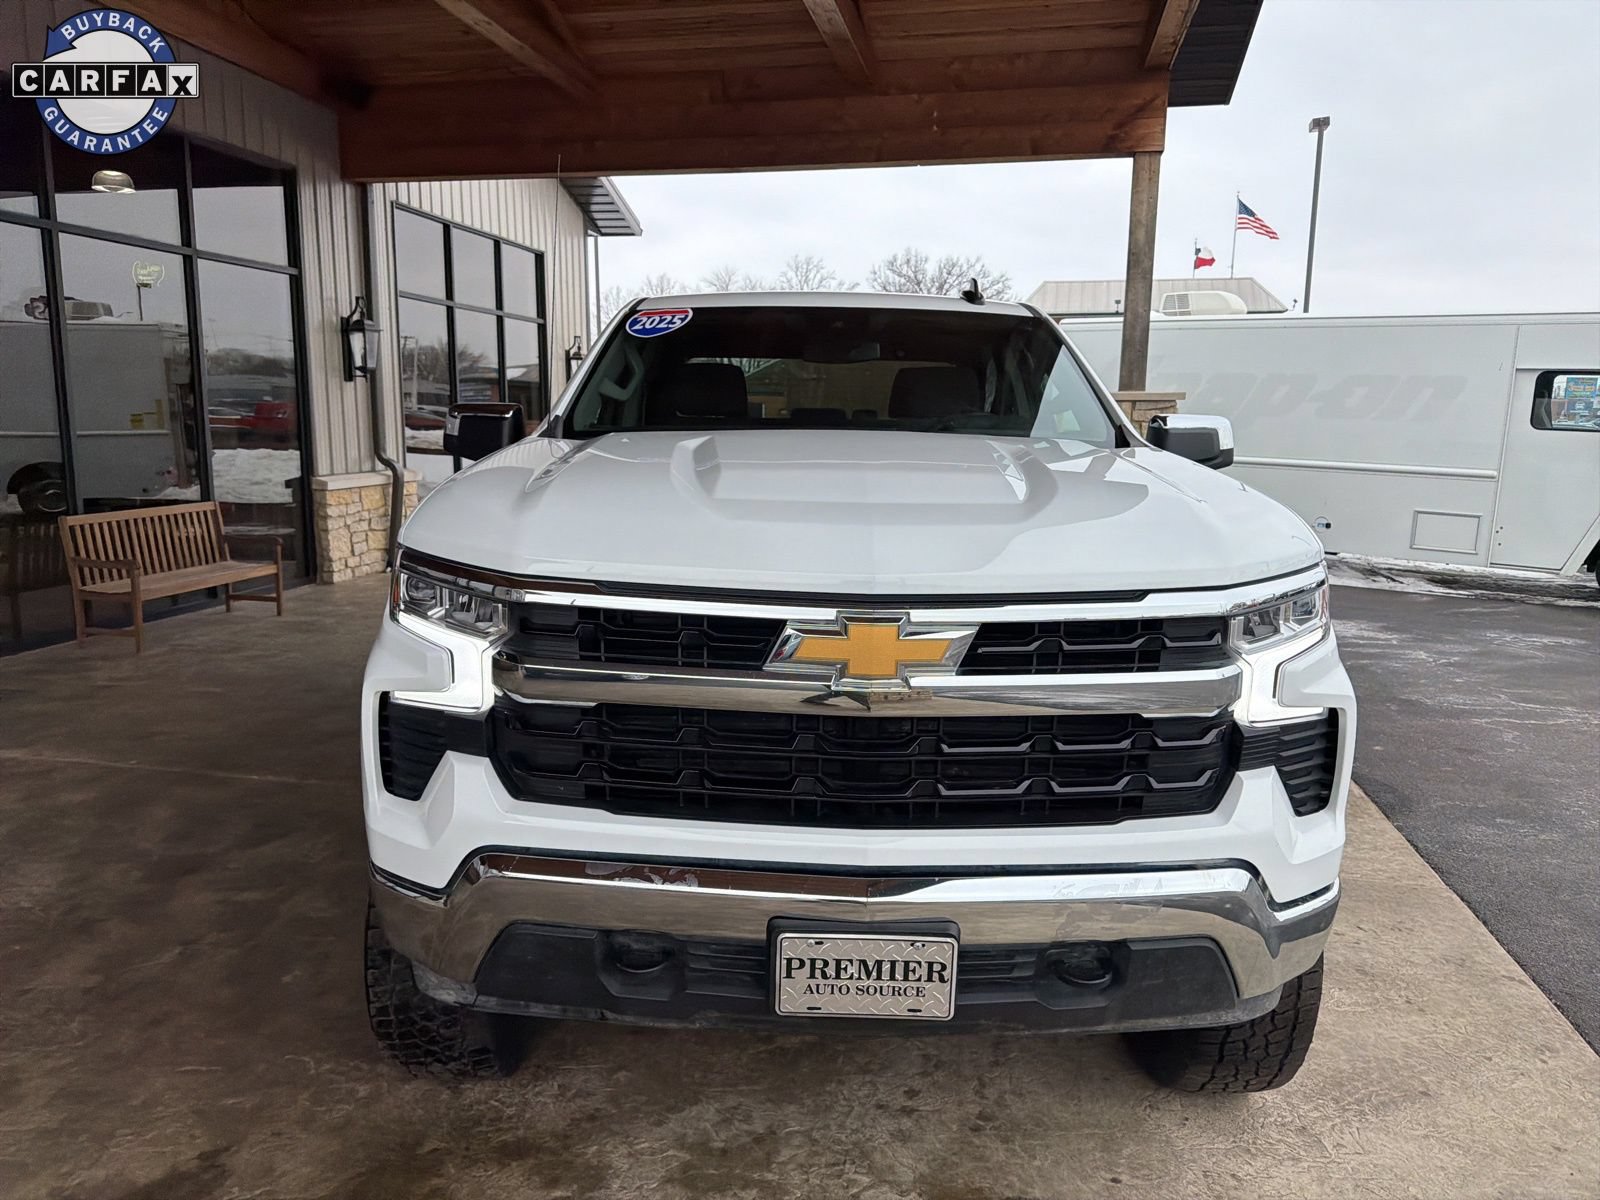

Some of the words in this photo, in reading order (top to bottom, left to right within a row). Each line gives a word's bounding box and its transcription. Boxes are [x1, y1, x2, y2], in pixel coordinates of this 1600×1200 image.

[630, 314, 686, 330] 2025
[782, 957, 950, 984] PREMIER
[803, 983, 850, 995] AUTO
[855, 984, 926, 998] SOURCE
